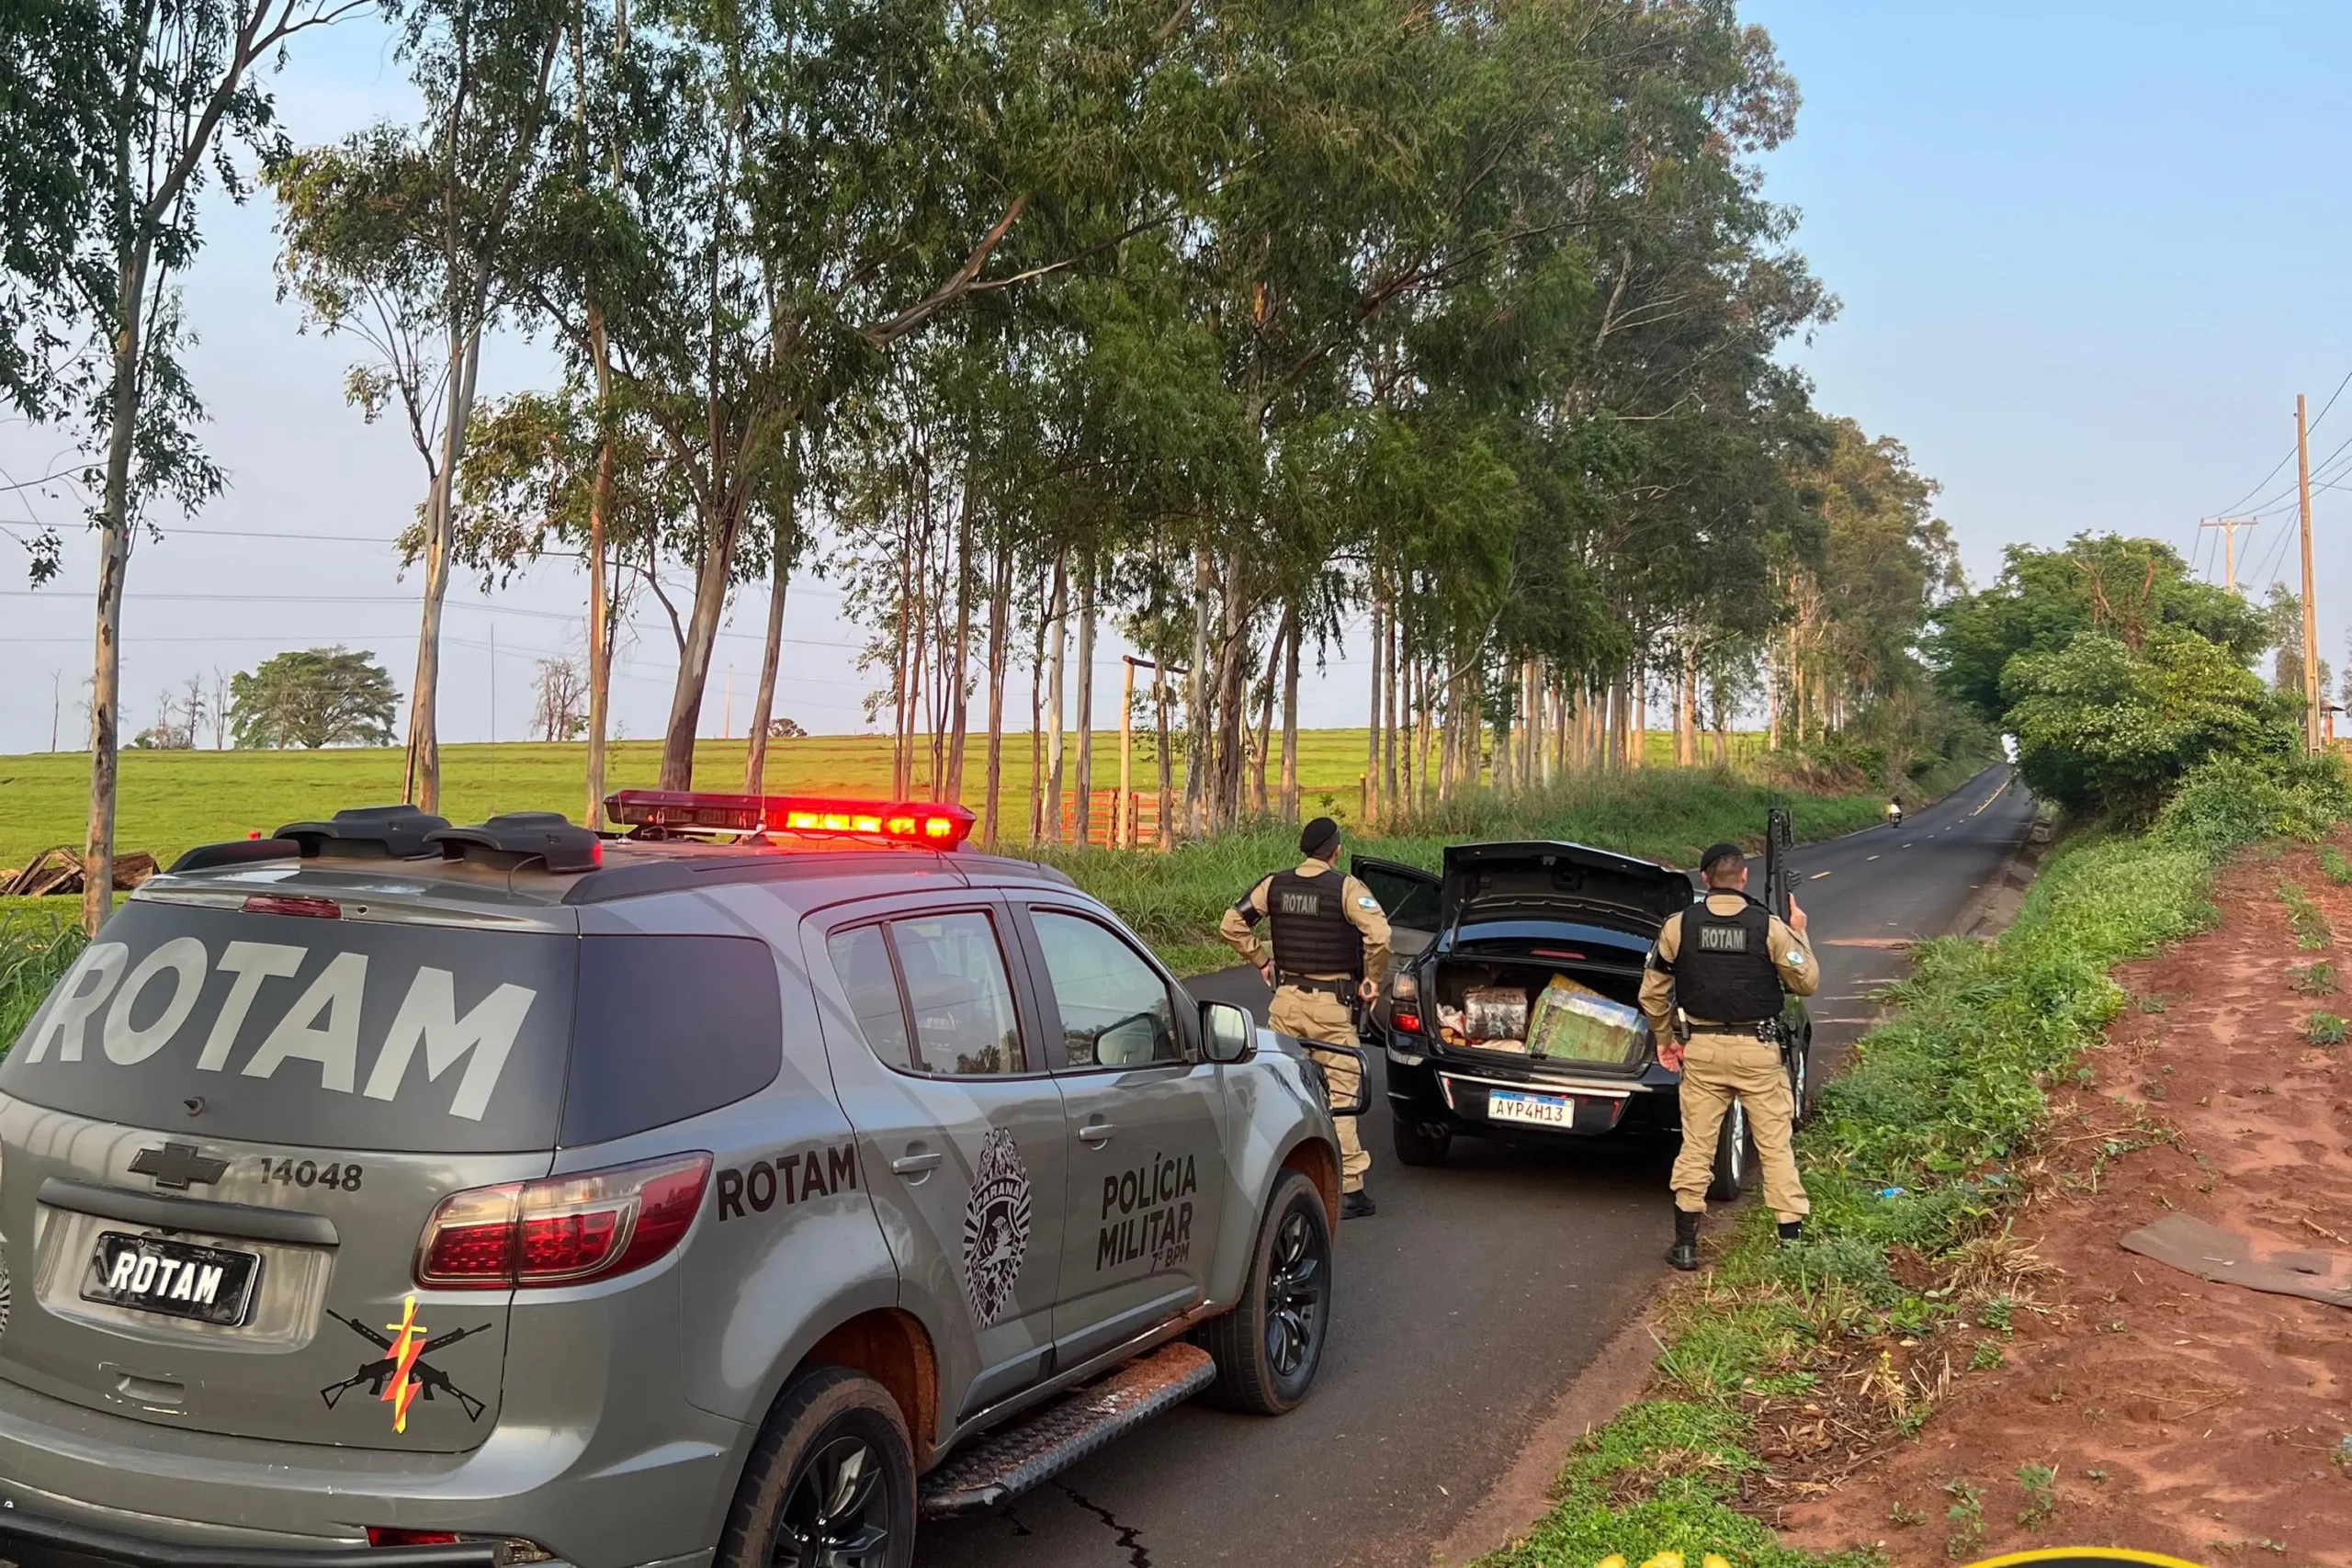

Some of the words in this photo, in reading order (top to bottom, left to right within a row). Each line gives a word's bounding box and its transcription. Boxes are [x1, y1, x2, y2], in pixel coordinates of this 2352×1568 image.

[1283, 893, 1317, 915] ROTAM
[1702, 928, 1743, 950] ROTAM
[25, 936, 538, 1122] ROTAM
[1496, 1100, 1564, 1122] AYP4H13
[260, 1157, 364, 1192] 14048
[716, 1143, 857, 1223] ROTAM
[1101, 1151, 1196, 1221] POLÍCIA
[975, 1181, 1020, 1213] PARANÁ
[1095, 1201, 1193, 1272] MILITAR
[1164, 1241, 1191, 1268] BPM
[108, 1251, 225, 1305] ROTAM
